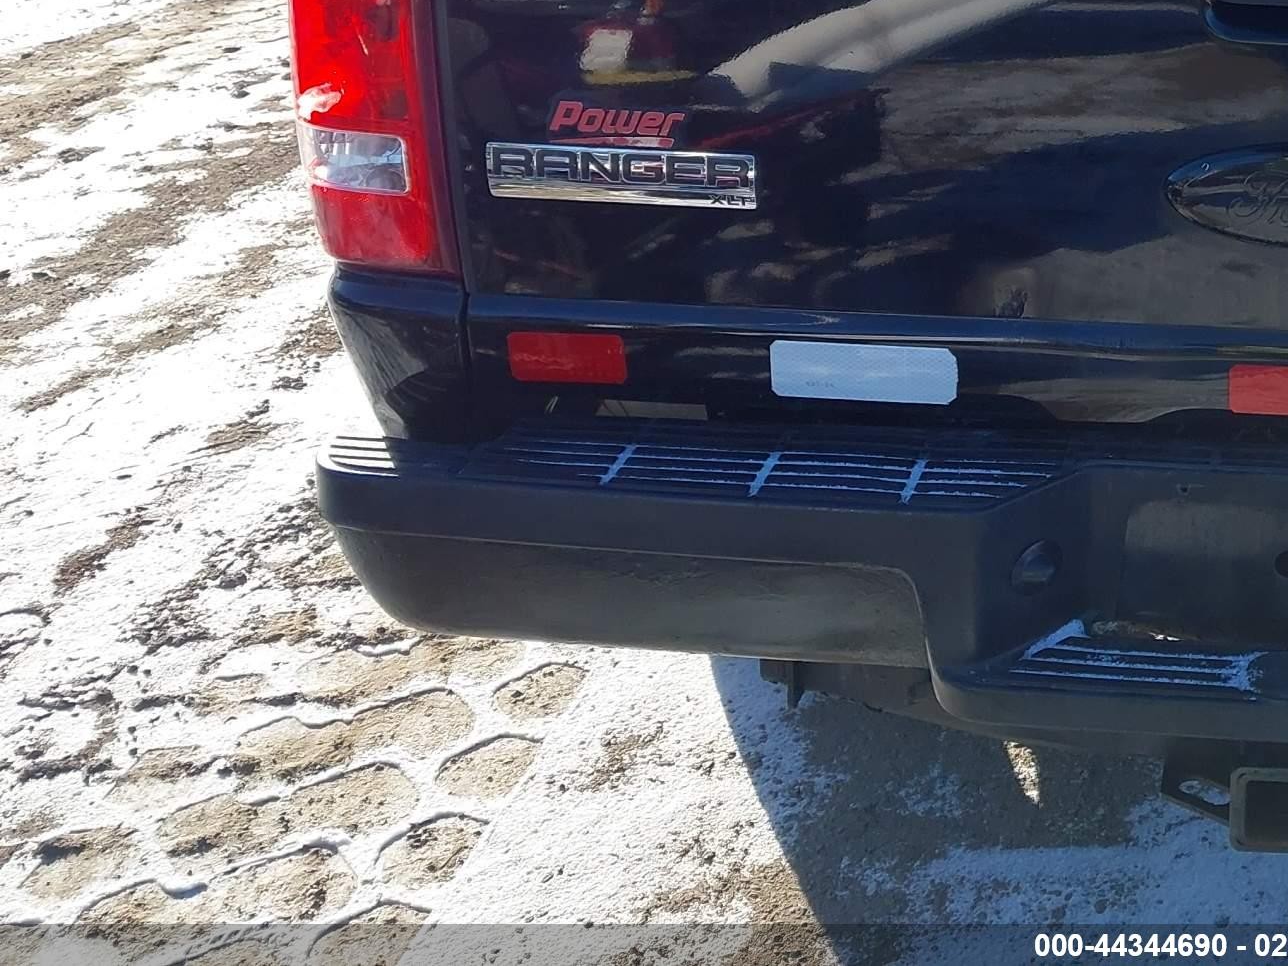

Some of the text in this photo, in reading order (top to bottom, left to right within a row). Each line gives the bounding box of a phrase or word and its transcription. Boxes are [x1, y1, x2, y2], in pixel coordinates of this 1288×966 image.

[550, 100, 685, 137] Power
[491, 146, 752, 189] RANGER
[711, 194, 752, 206] XLT
